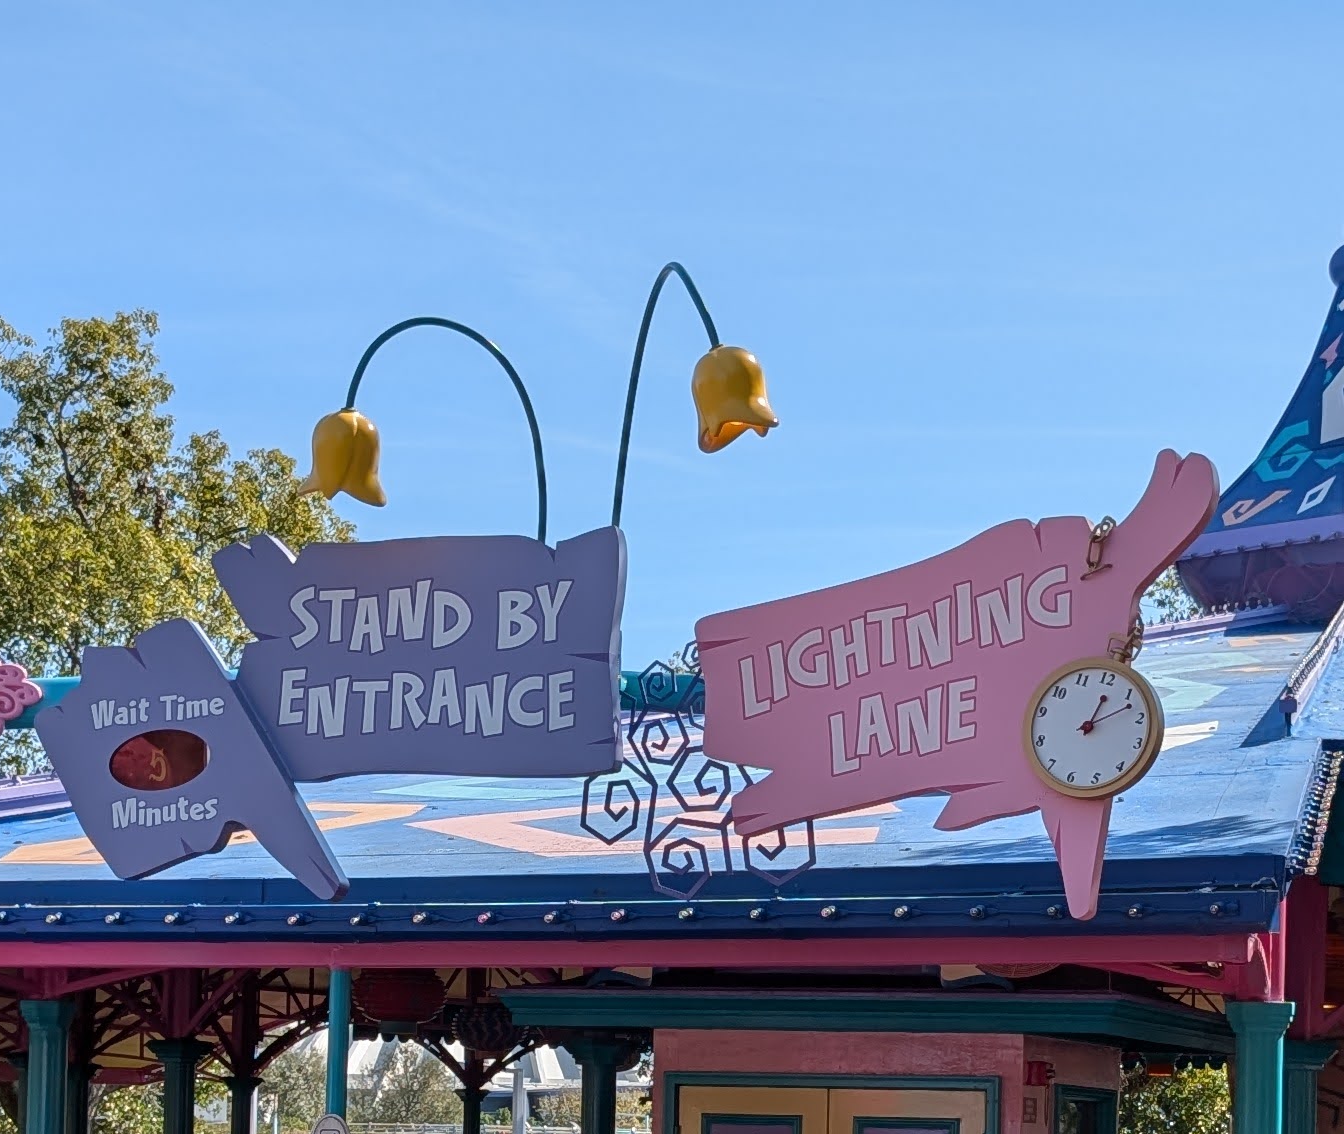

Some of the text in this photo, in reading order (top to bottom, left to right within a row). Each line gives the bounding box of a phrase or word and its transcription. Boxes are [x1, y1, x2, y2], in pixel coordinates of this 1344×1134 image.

[288, 578, 574, 655] STAND BY
[738, 564, 1073, 720] LIGHTNING
[1074, 673, 1089, 687] 11
[1099, 672, 1116, 686] 12
[1052, 686, 1067, 699] 10
[1124, 688, 1133, 700] 1
[277, 666, 576, 739] ENTRANCE
[90, 694, 225, 730] Wait Time
[1037, 706, 1047, 718] 9
[1135, 712, 1145, 724] 2
[828, 676, 977, 777] LANE
[1036, 735, 1045, 747] 8
[1133, 737, 1143, 749] 3
[148, 748, 167, 782] 5
[1047, 758, 1056, 771] 7
[1115, 761, 1125, 772] 4
[1066, 771, 1077, 783] 6
[1090, 772, 1102, 784] 5
[111, 796, 218, 829] Minutes
